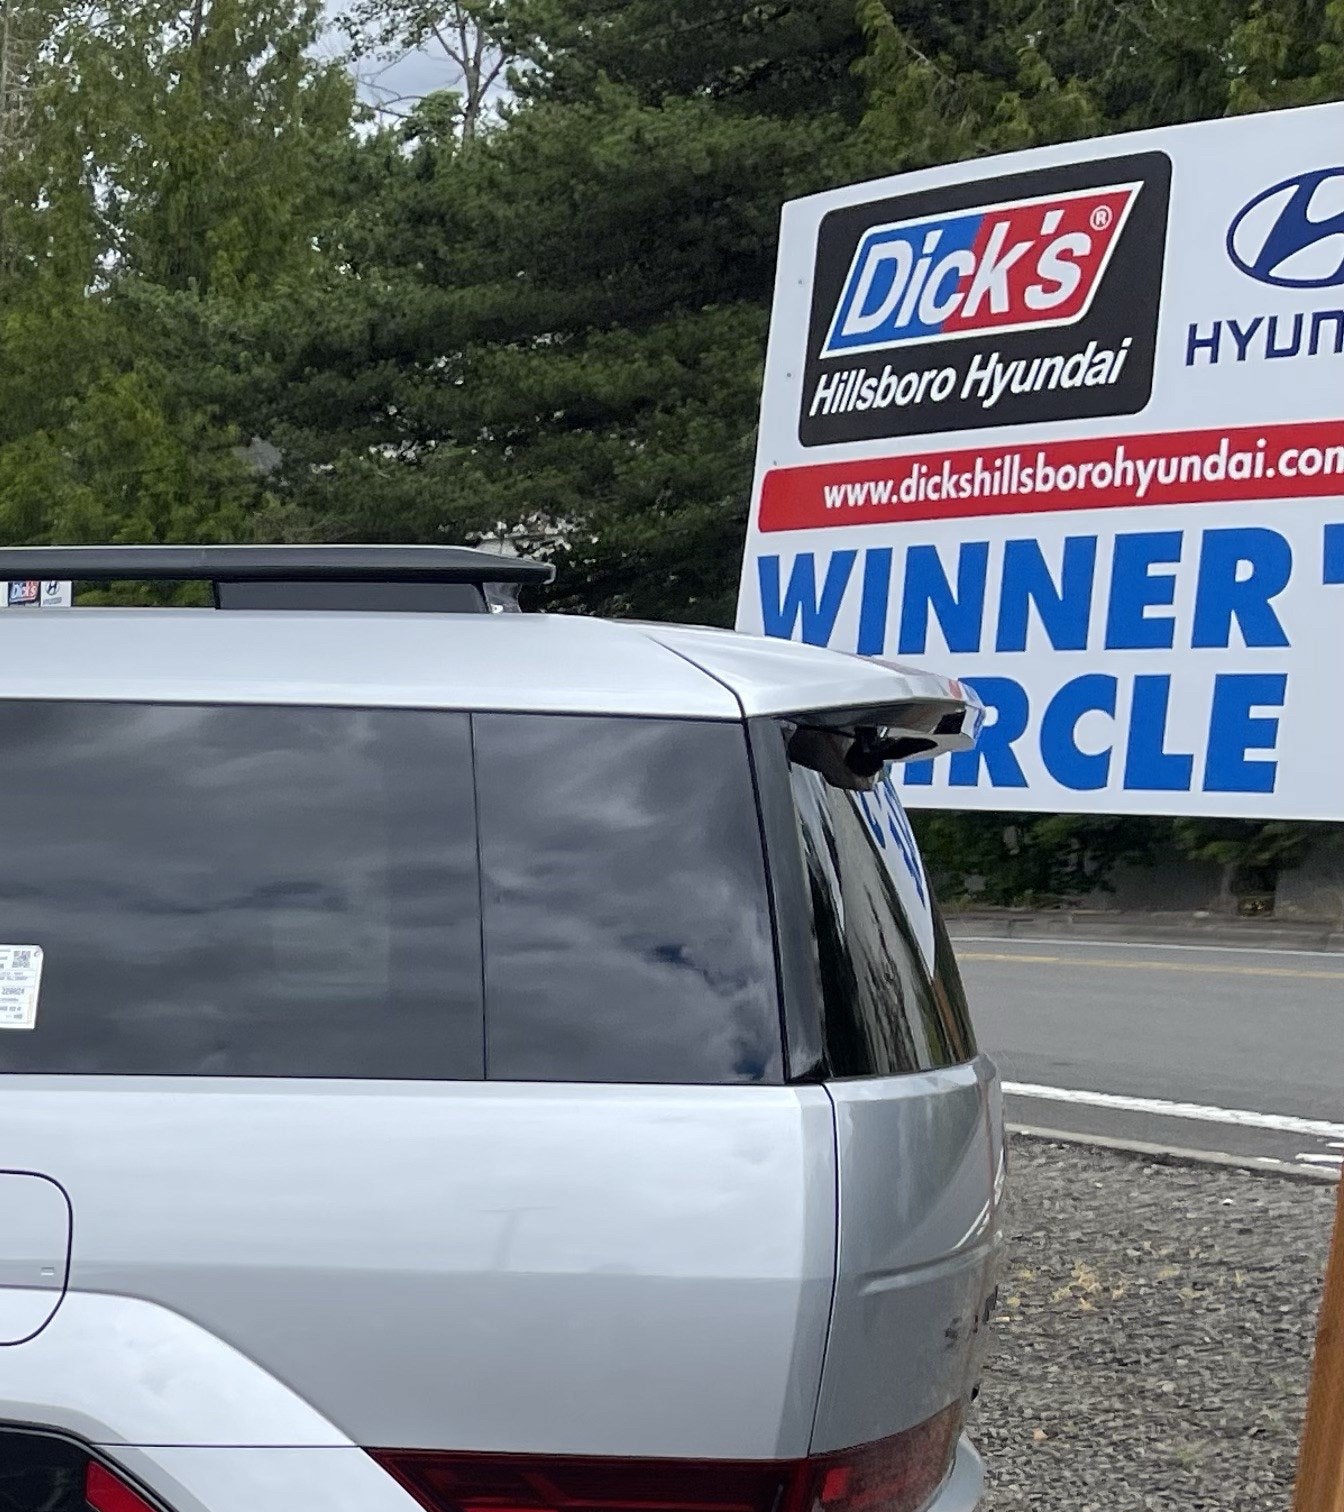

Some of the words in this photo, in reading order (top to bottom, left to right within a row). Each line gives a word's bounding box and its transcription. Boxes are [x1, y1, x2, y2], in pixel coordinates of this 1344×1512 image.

[809, 365, 957, 417] Hillsboro
[960, 337, 1133, 409] Hyundai
[757, 526, 1292, 657] WINNER
[903, 672, 1289, 793] RCLE
